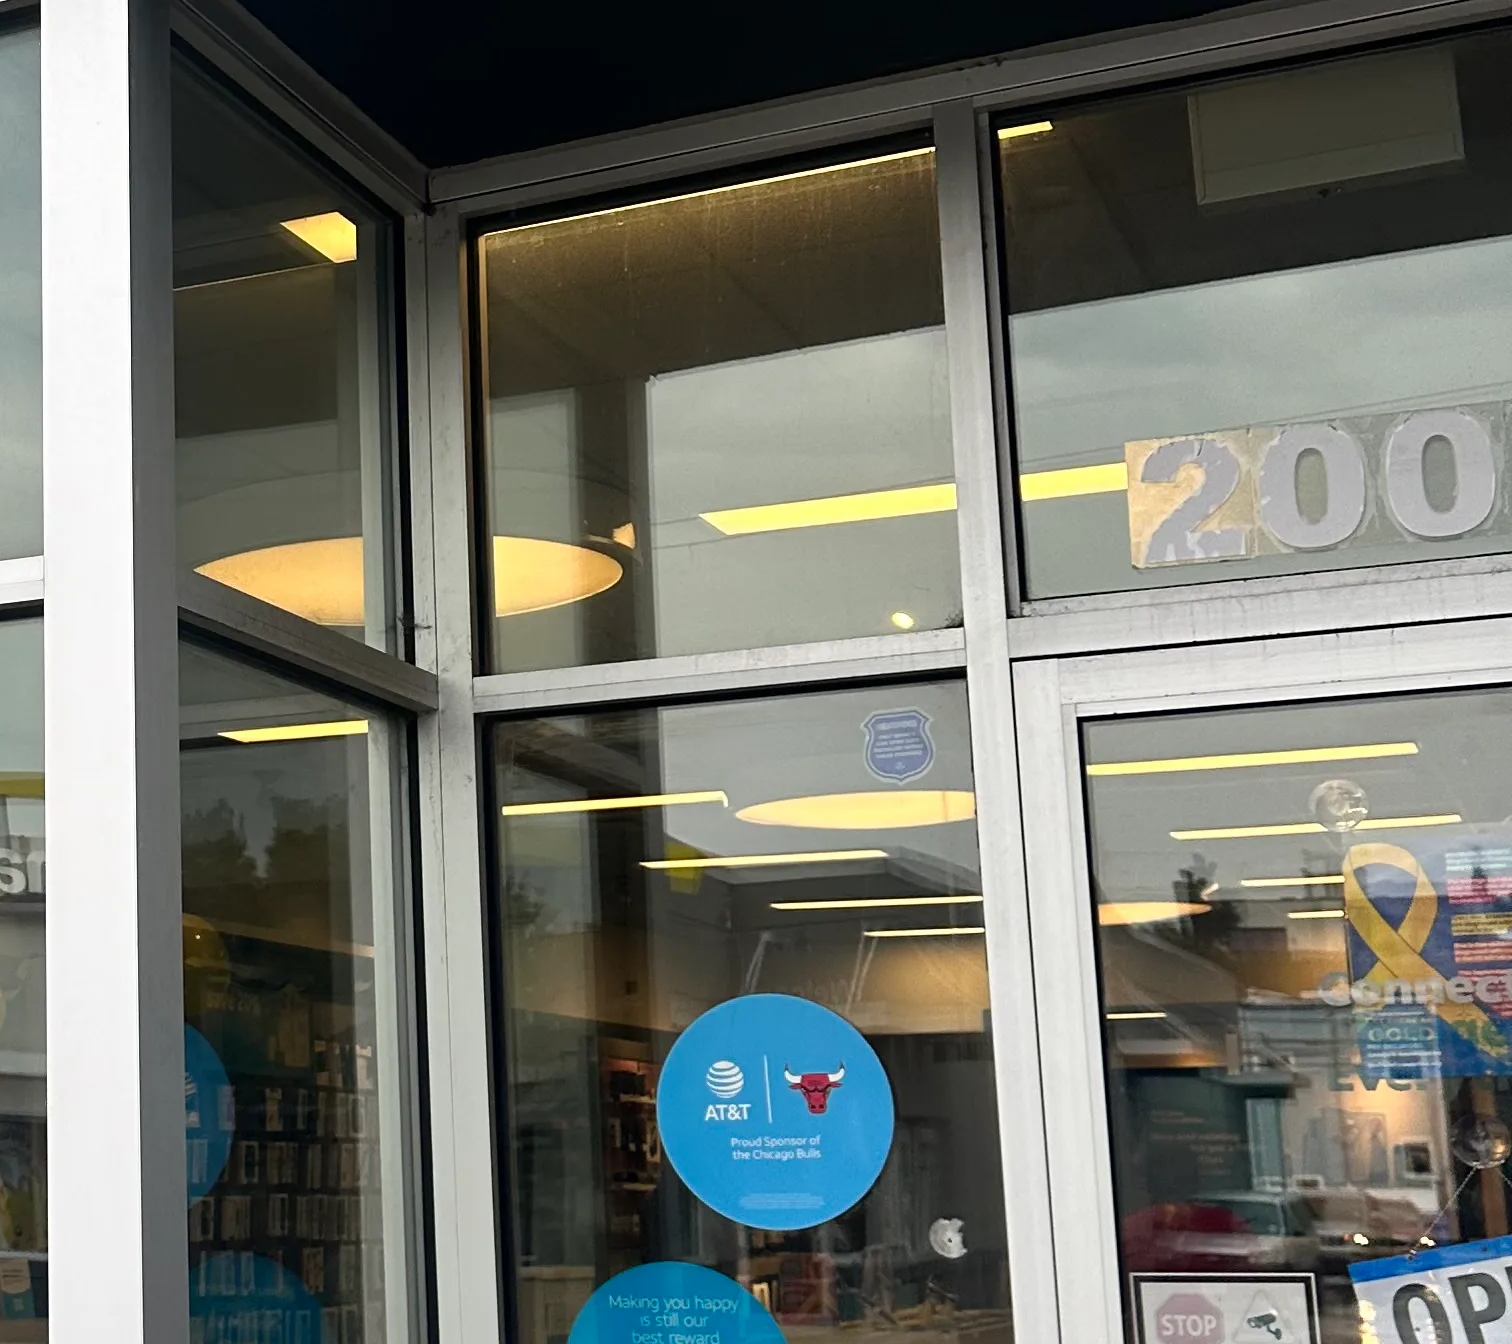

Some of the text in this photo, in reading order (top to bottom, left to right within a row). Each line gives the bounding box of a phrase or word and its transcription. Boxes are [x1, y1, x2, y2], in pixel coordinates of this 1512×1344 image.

[1140, 410, 1496, 566] 200
[704, 1103, 751, 1121] AT&T
[731, 1134, 821, 1148] Proud Sponsor of
[732, 1148, 821, 1161] the Chicago Bulls
[609, 1295, 738, 1313] Making you happy
[640, 1312, 708, 1327] is still our
[1160, 1315, 1217, 1336] STOP
[632, 1332, 664, 1344] best
